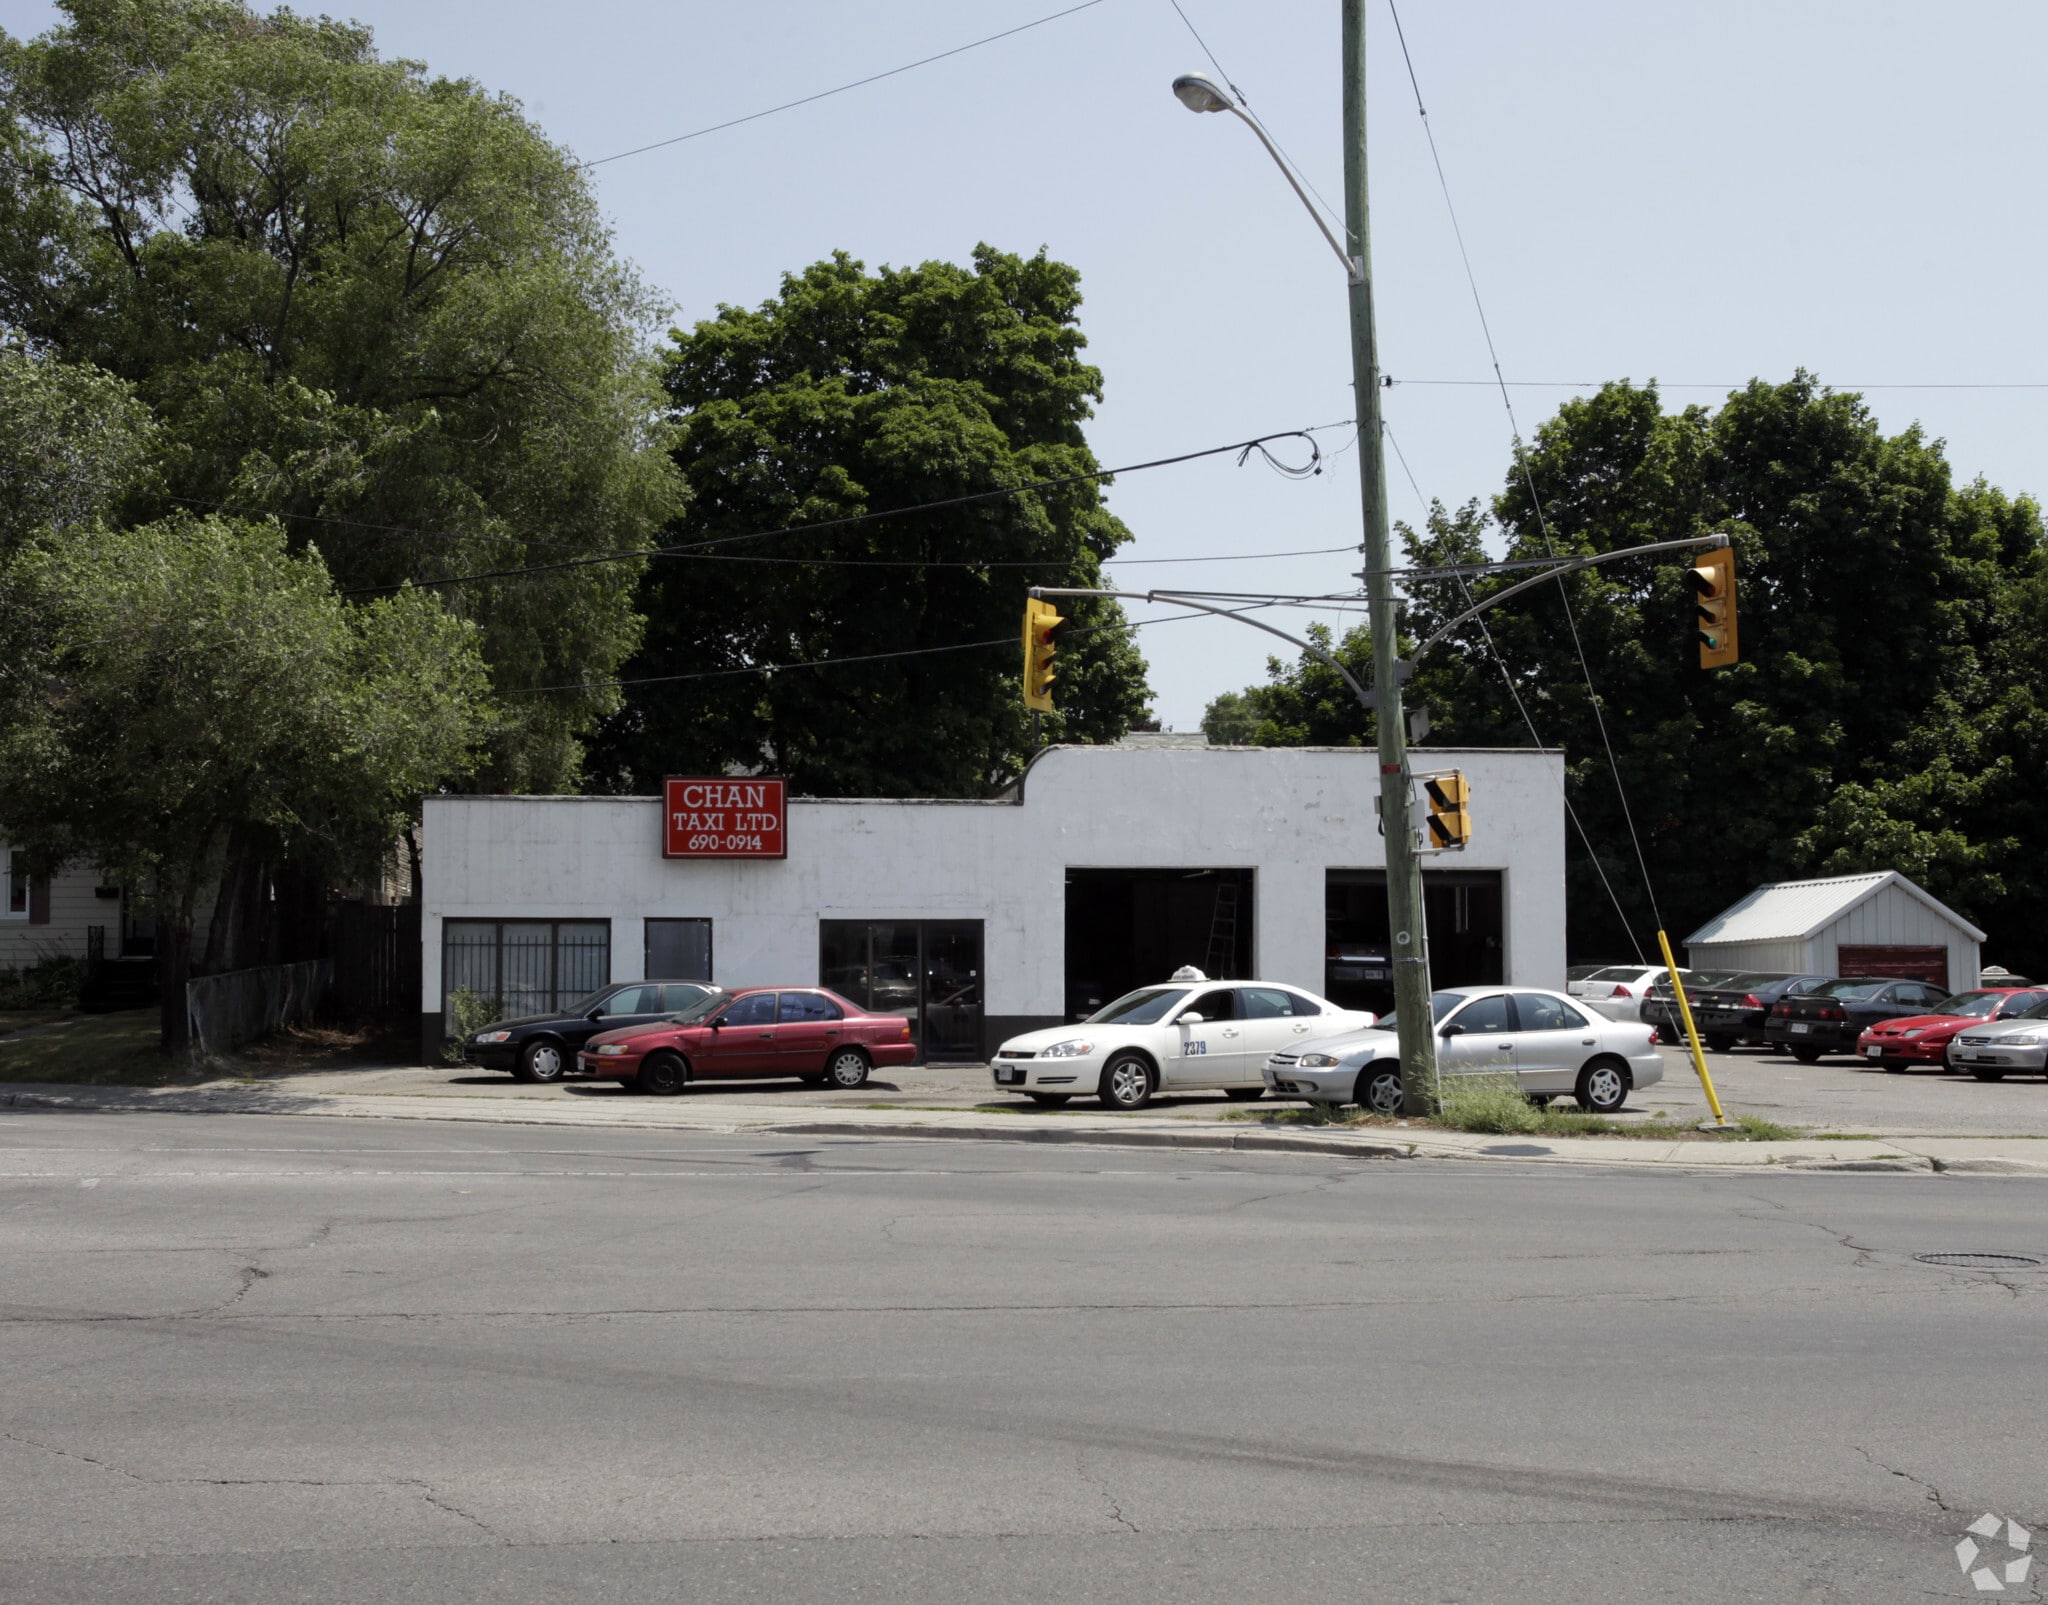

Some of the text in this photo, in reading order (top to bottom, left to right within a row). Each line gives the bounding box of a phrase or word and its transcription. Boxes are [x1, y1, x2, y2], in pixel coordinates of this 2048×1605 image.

[683, 785, 766, 808] CHAN
[673, 813, 725, 831] TAXI
[688, 834, 762, 850] 690-0914
[1184, 1040, 1207, 1056] 2379
